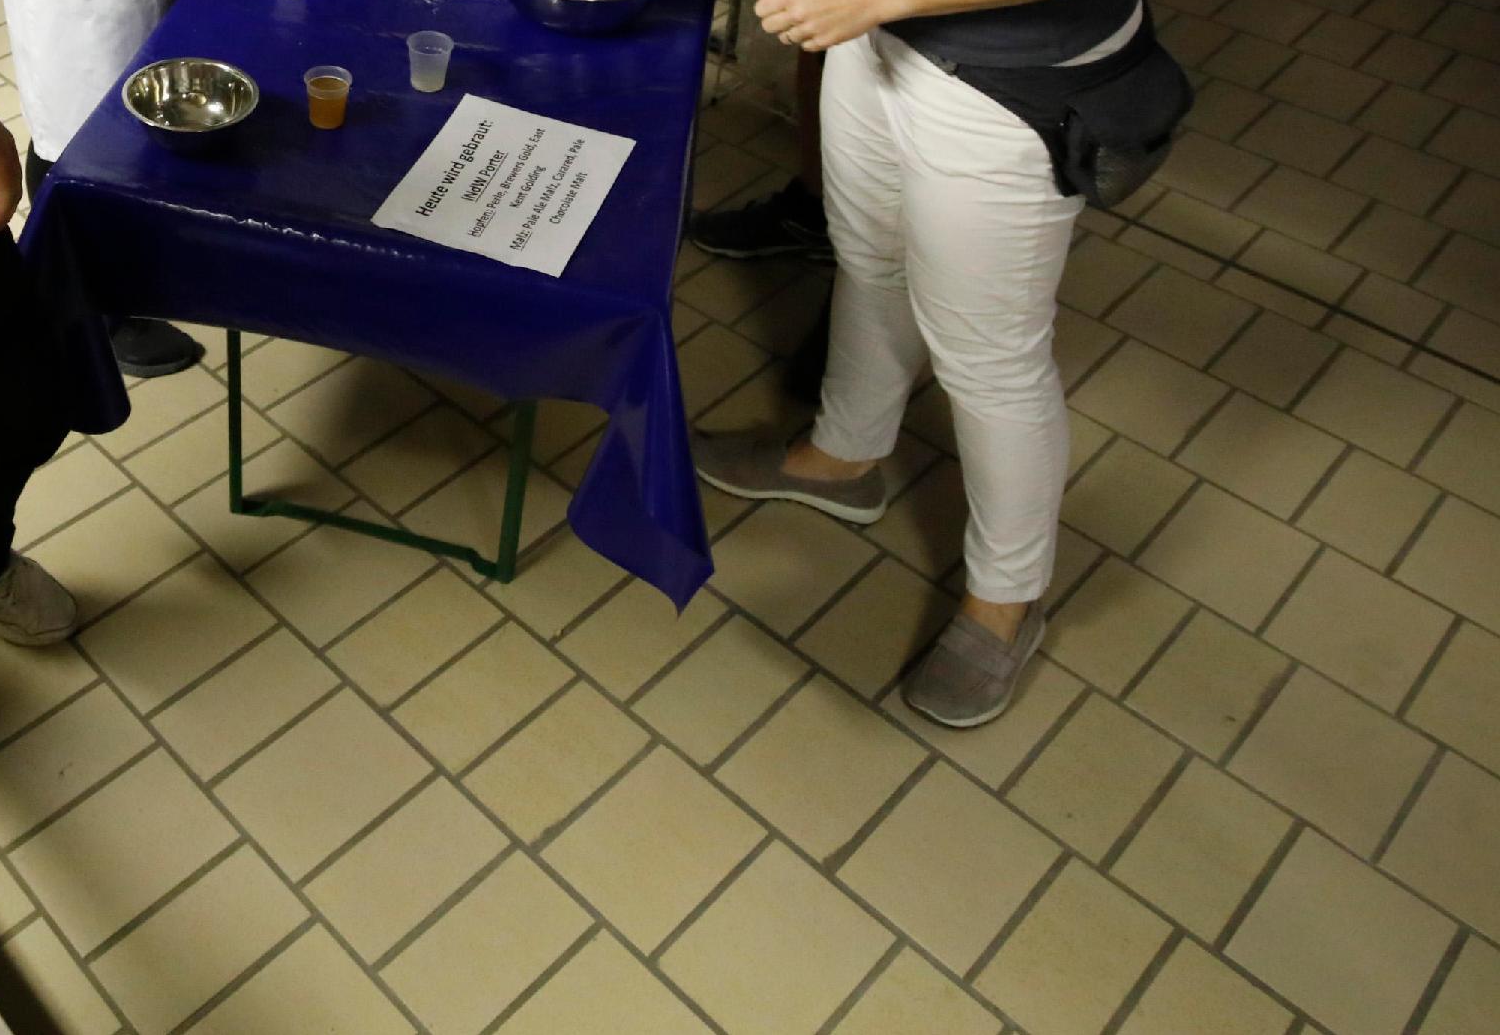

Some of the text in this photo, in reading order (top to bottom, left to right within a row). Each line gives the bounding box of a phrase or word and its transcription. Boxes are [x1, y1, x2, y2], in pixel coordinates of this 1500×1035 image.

[415, 119, 494, 217] Heute wird gebraut:
[468, 128, 546, 238] Hopfen: Perle, Brewers Gold, East
[478, 150, 505, 177] Porter
[509, 164, 547, 208] Kent Golding
[509, 229, 531, 250] Malz:
[522, 213, 540, 230] Pale
[532, 200, 547, 214] Ale
[569, 138, 586, 154] Pale
[549, 189, 578, 225] Chocolate
